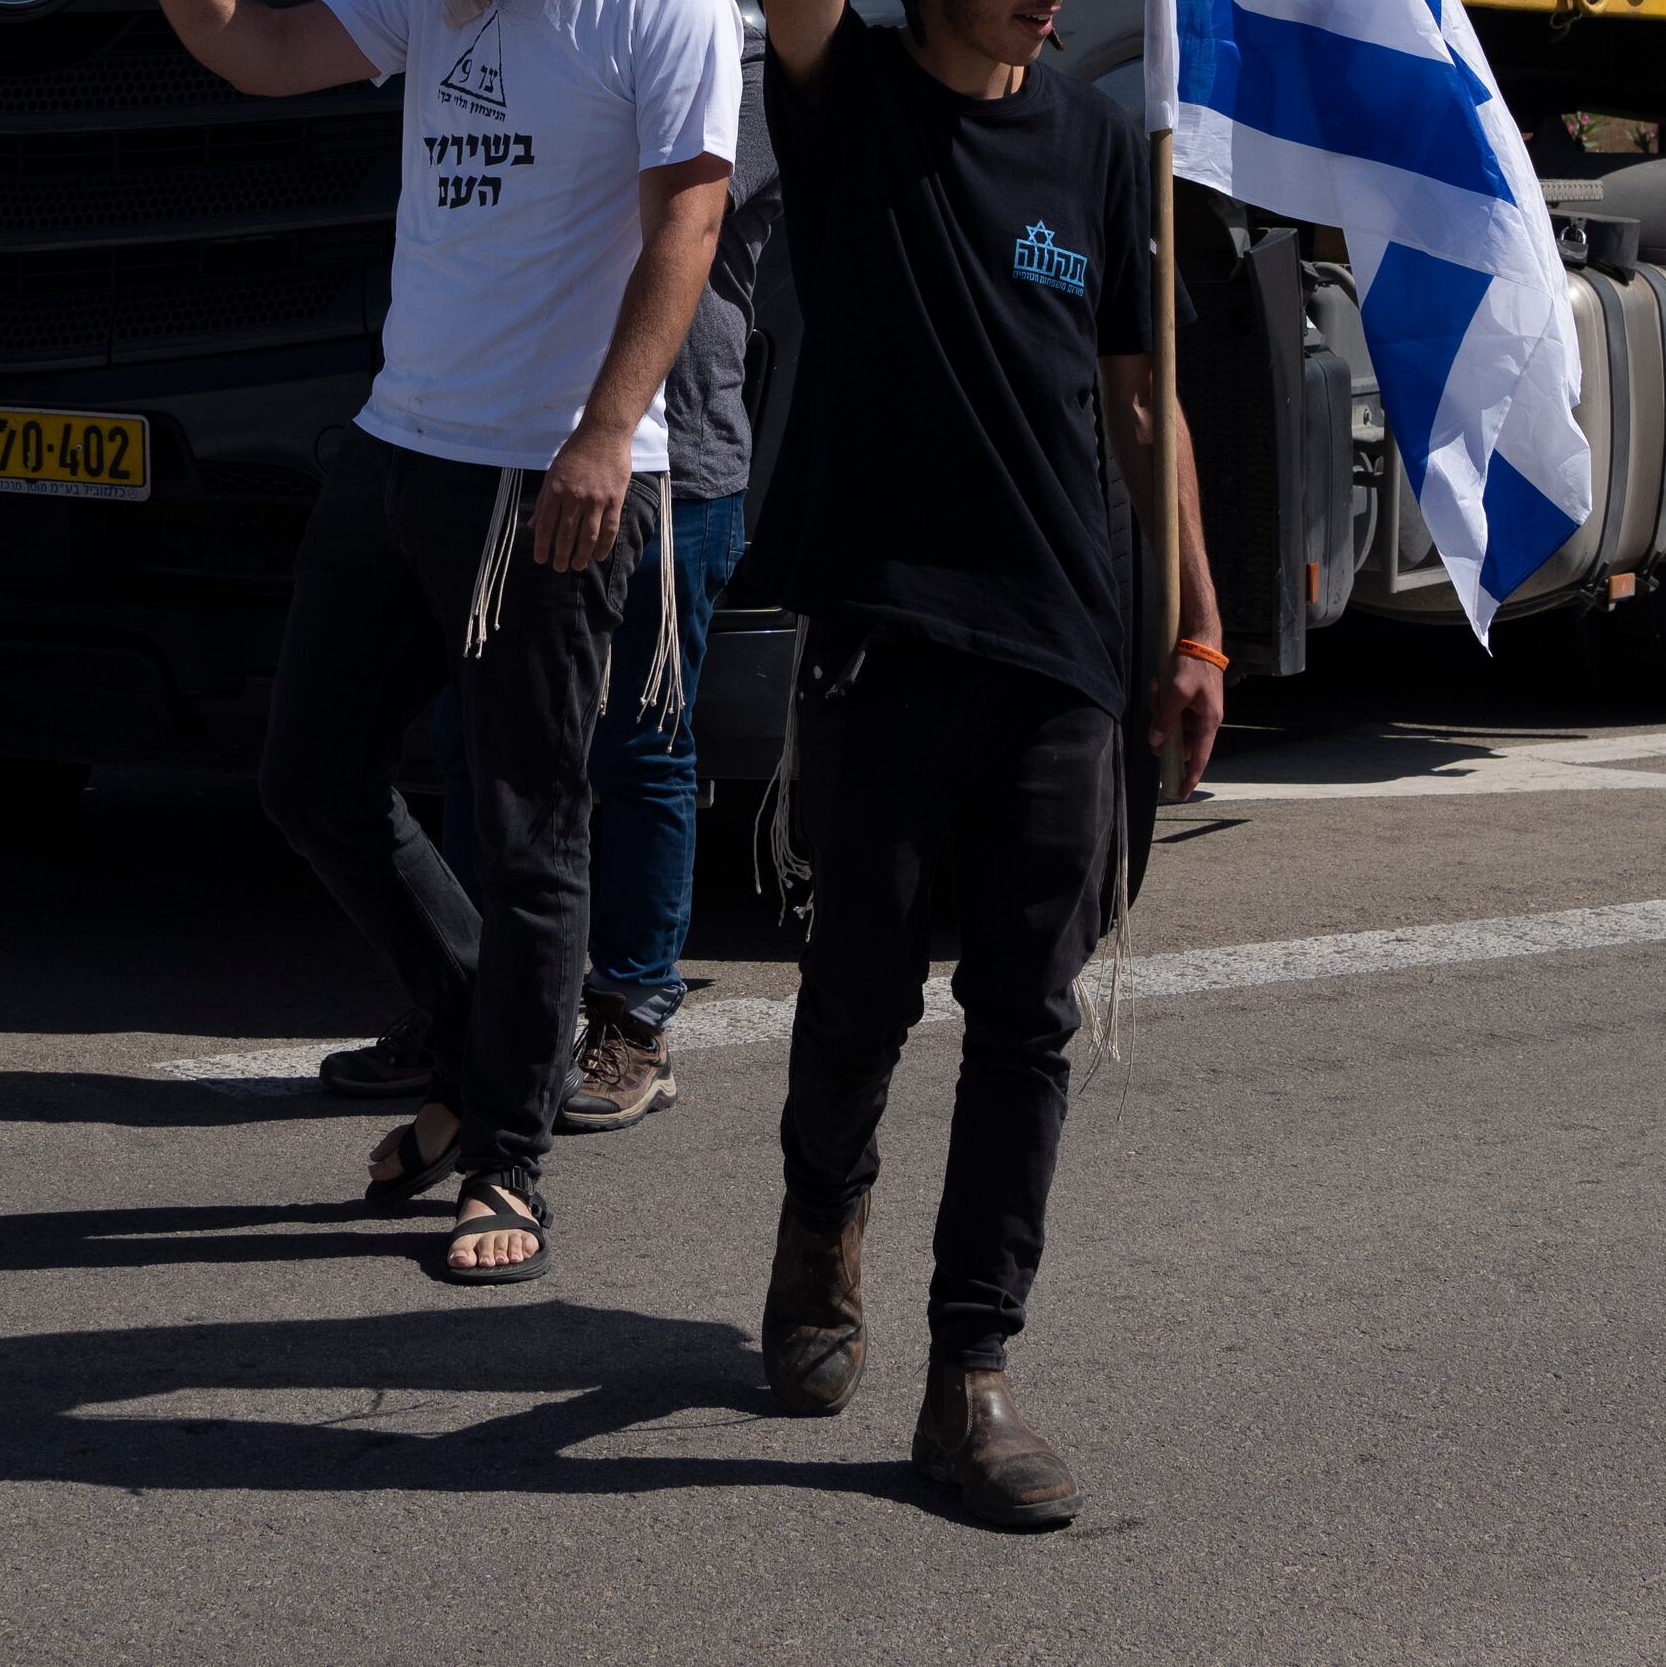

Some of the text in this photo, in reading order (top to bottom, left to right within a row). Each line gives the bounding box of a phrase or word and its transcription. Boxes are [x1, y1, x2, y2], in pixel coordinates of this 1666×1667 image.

[458, 58, 473, 83] 9
[453, 94, 468, 109] תלוי
[469, 101, 506, 122] הניצחון
[438, 174, 502, 209] העם
[1014, 239, 1088, 286] תקווה
